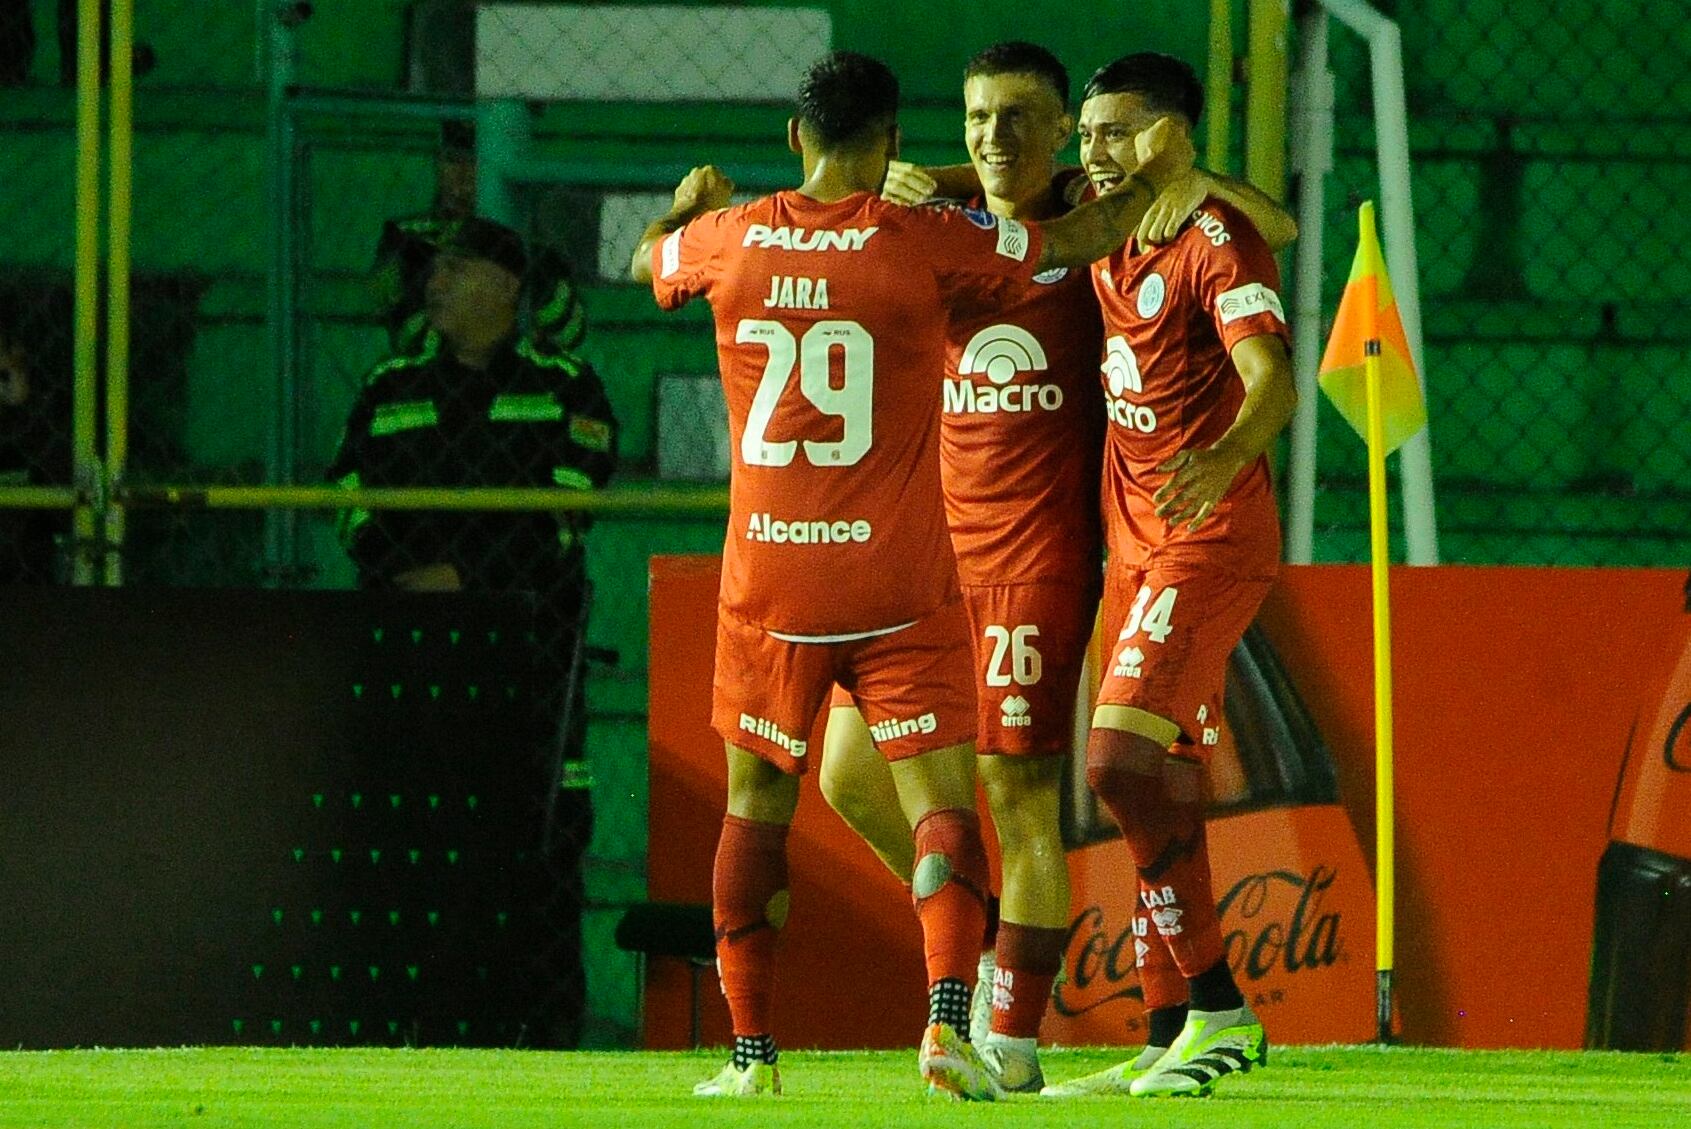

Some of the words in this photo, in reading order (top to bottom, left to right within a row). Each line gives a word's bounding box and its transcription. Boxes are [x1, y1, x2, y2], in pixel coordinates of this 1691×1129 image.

[742, 224, 879, 251] PAUNY
[763, 276, 829, 310] JARA
[735, 319, 874, 467] 29
[943, 379, 1063, 414] Macro
[746, 513, 872, 544] Alcance
[984, 625, 1042, 687] 26
[739, 713, 807, 758] Riiing
